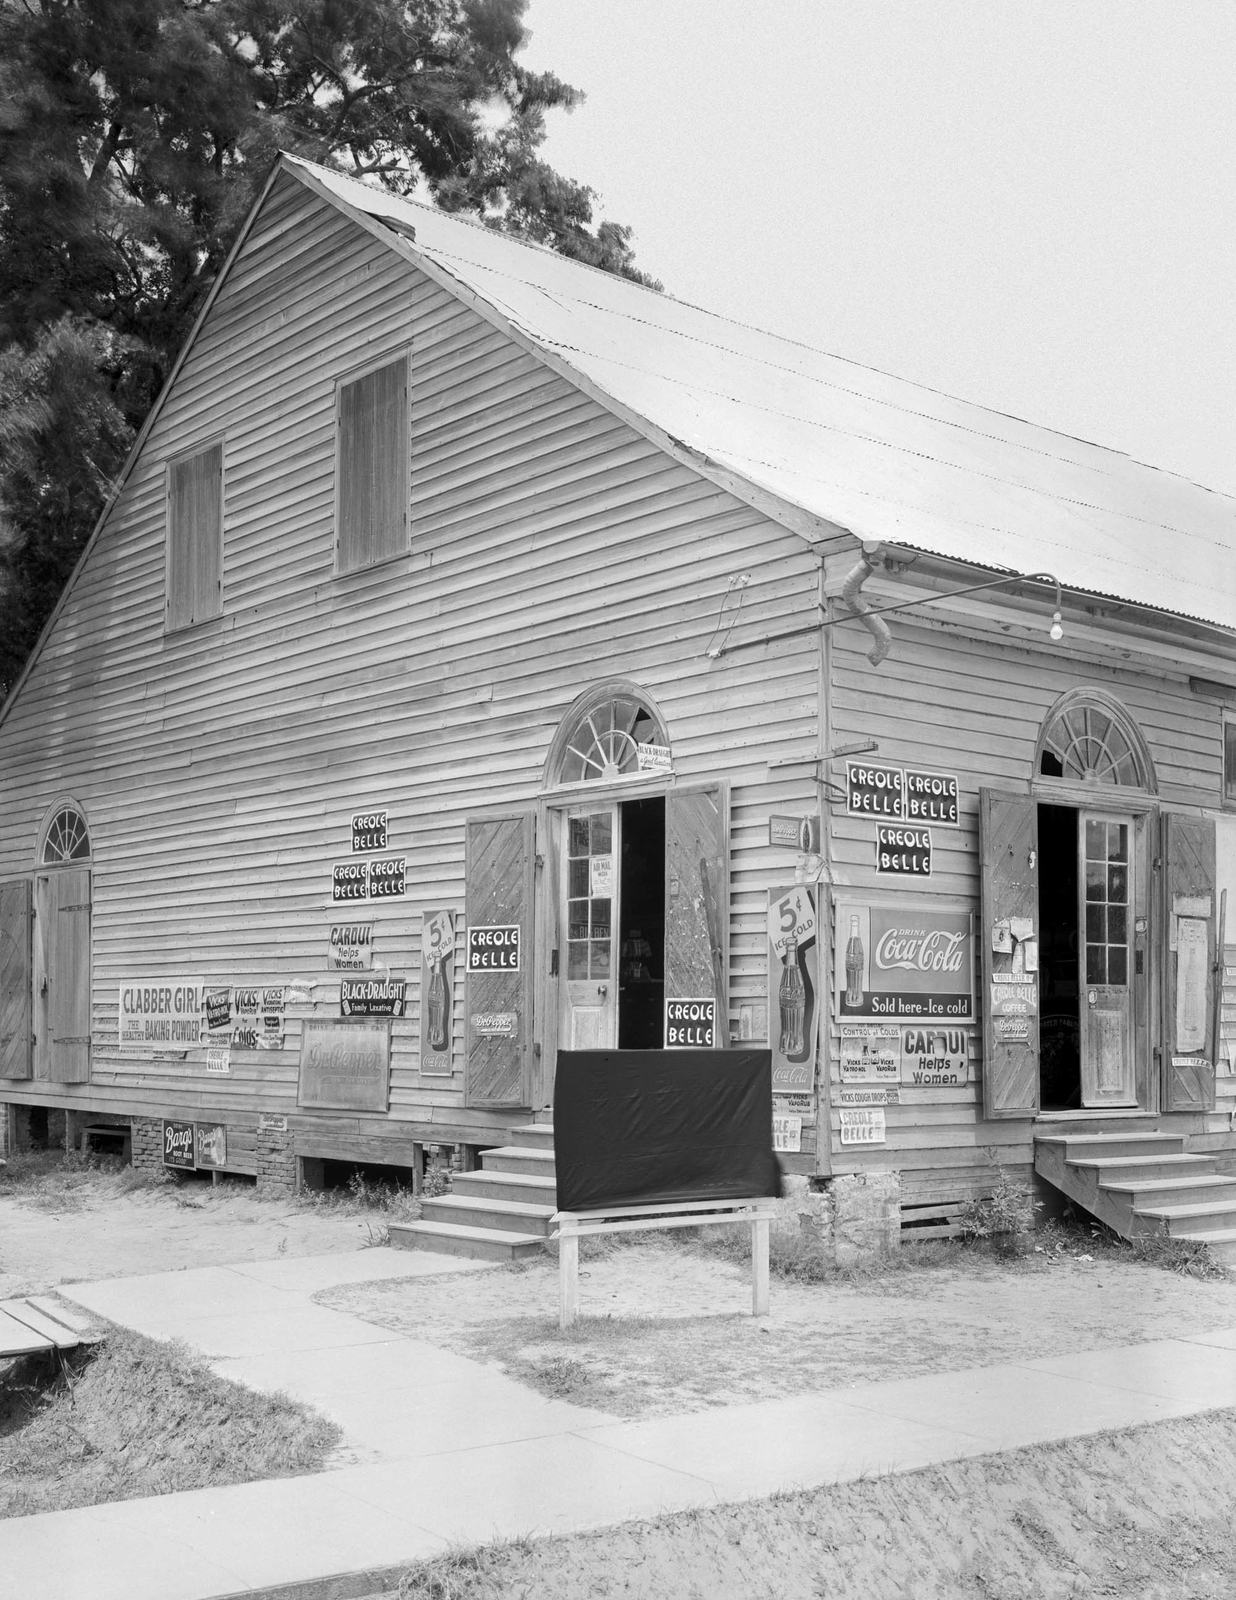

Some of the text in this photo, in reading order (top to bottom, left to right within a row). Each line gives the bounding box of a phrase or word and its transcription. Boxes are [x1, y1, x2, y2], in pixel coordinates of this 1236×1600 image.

[851, 768, 901, 790] CREOLE
[908, 776, 956, 797] CREOLE
[852, 792, 900, 814] BELLE
[910, 799, 956, 820] BELLE
[353, 814, 386, 830] CREOLE
[354, 833, 386, 849] BELLE
[880, 829, 930, 849] CREOLE
[370, 860, 404, 876] CREOLE
[881, 852, 929, 872] BELLE
[334, 865, 366, 879] CREOLE
[335, 884, 366, 898] BELLE
[371, 880, 404, 895] BELLE
[331, 926, 370, 946] CARDUI
[471, 931, 518, 946] CREOLE
[774, 919, 814, 951] ICE COLD
[898, 929, 927, 937] DRINK
[338, 947, 360, 959] Helps
[426, 936, 453, 962] ICE COLD
[875, 928, 967, 972] Coca-Cola
[334, 959, 364, 969] Women
[472, 952, 517, 967] BELLE
[263, 989, 282, 1005] VICKS
[342, 981, 404, 1000] BLACK-DRAUGHT
[992, 986, 1037, 1008] CREOLE BELLE
[123, 986, 200, 1014] CLABBER GIRL
[235, 990, 258, 1015] VICKS
[351, 1002, 392, 1013] Family Laxative
[872, 996, 896, 1013] Sold
[946, 999, 968, 1014] cold
[1002, 1004, 1027, 1012] COFFEE
[668, 1004, 713, 1020] CREOLE
[128, 1020, 140, 1030] THE
[145, 1020, 170, 1041] BAKING
[171, 1020, 200, 1042] POWDER
[843, 1027, 870, 1036] CONTROL
[880, 1027, 899, 1036] COLDS
[669, 1027, 712, 1044] BELLE
[918, 1057, 951, 1072] Helps
[912, 1072, 957, 1084] Women
[841, 1092, 854, 1103] VICKS
[855, 1092, 871, 1103] COUGH
[871, 1092, 887, 1103] DROPS
[843, 1112, 873, 1126] CREOLE
[843, 1127, 874, 1140] BELLE
[183, 1151, 192, 1159] BEER
